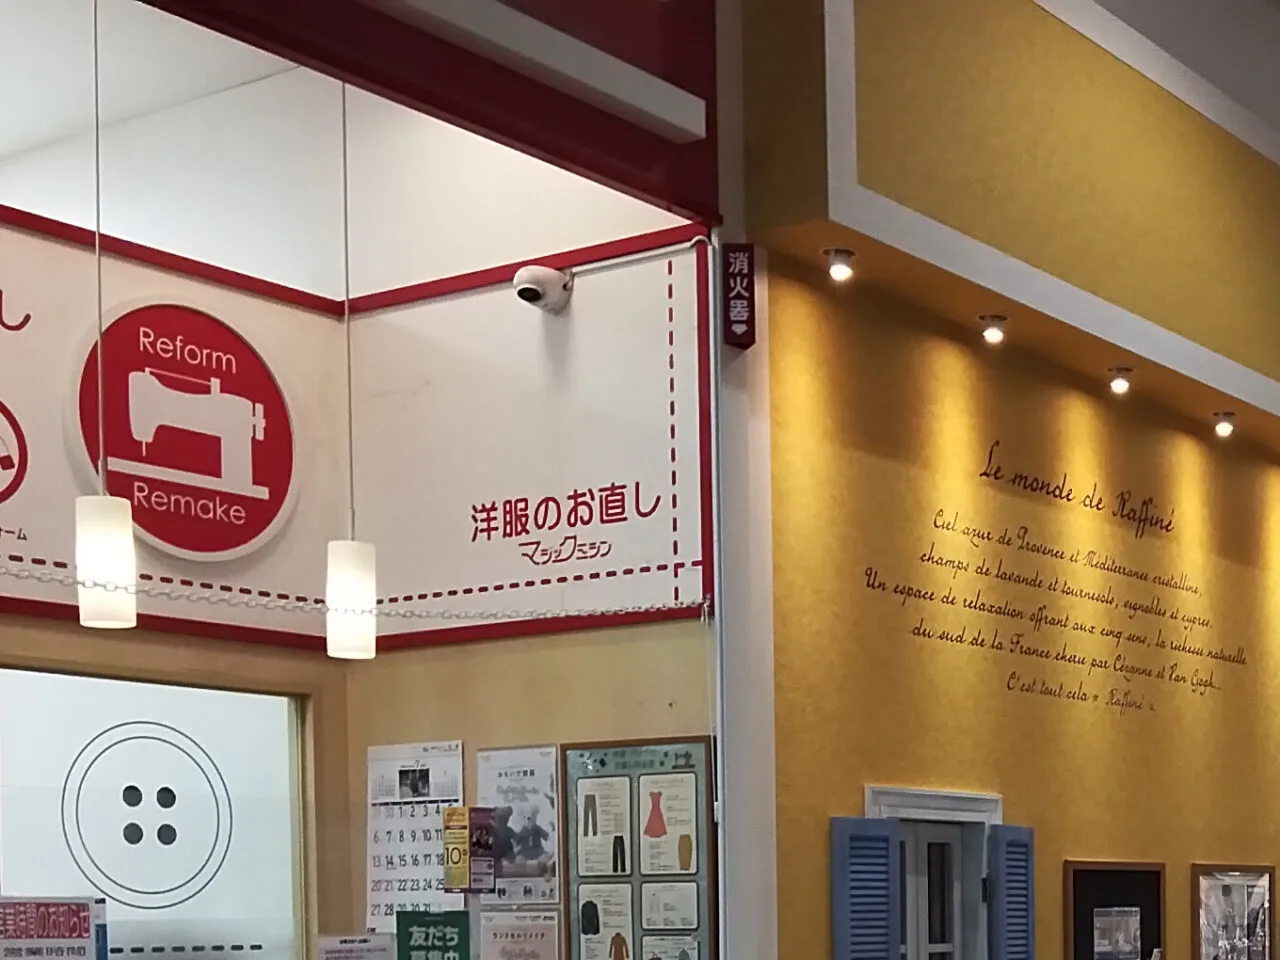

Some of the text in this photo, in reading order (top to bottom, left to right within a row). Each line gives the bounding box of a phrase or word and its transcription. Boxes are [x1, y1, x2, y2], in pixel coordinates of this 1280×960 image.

[728, 251, 750, 321] 消火器
[139, 327, 237, 374] Reform
[134, 481, 246, 525] Remake
[471, 481, 662, 542] 洋服のお直し
[979, 440, 1175, 539] Le monde de Raffiné
[518, 535, 612, 565] マジックミシン
[997, 528, 1013, 547] de
[1017, 526, 1066, 560] Provence
[1069, 550, 1078, 564] et
[864, 567, 888, 591] Un
[893, 582, 936, 606] espace
[941, 587, 957, 606] de
[962, 589, 1025, 619] relaxation
[1029, 605, 1069, 632] offrant
[1072, 621, 1096, 634] aux
[1100, 627, 1123, 648] cinq
[1155, 628, 1168, 649] la
[920, 541, 970, 579] champs
[974, 558, 992, 577] de
[994, 558, 1043, 589] lavande
[1047, 576, 1059, 592] et
[1169, 608, 1179, 621] et
[912, 618, 934, 639] du
[938, 626, 967, 645] sud
[969, 629, 988, 647] de
[991, 629, 1005, 651] la
[1009, 633, 1052, 660] France
[1090, 658, 1110, 676] par
[1155, 667, 1166, 680] et
[1040, 679, 1064, 700] tout
[1066, 680, 1089, 701] cela
[409, 925, 460, 946] 友だち
